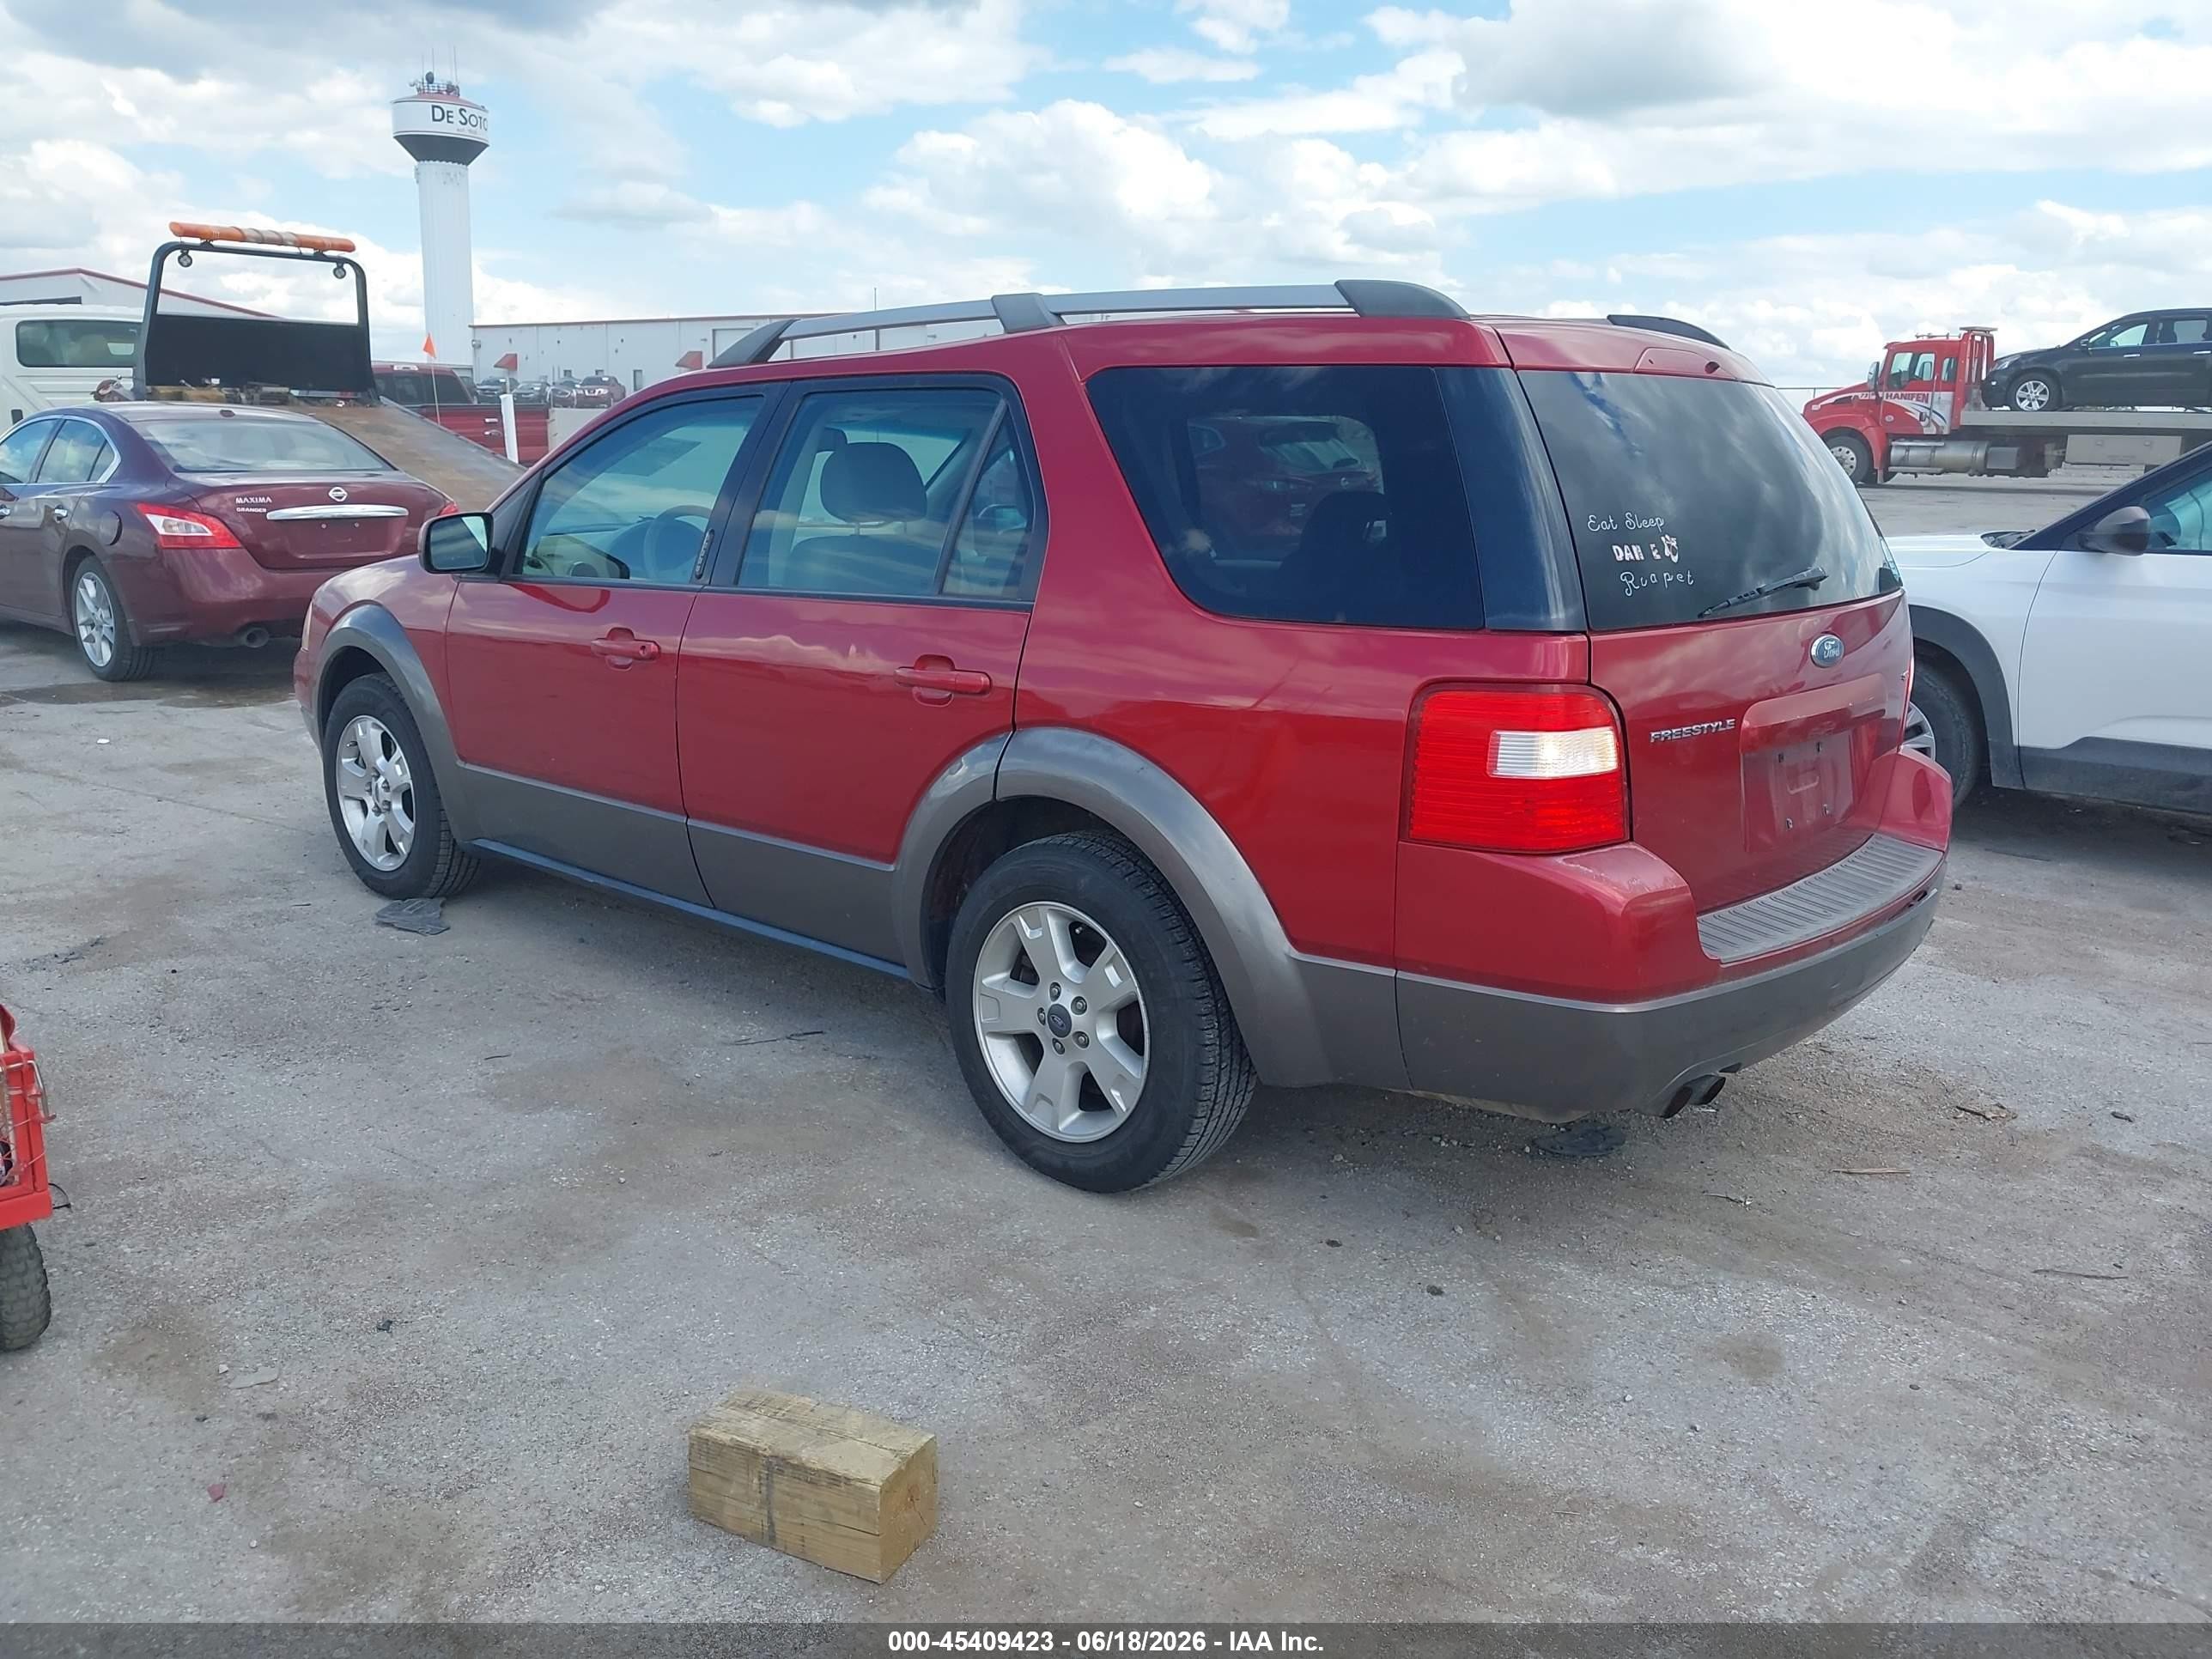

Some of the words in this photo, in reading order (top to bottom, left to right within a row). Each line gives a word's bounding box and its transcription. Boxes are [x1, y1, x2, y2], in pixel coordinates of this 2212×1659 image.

[1587, 514, 1618, 532] Eat
[1625, 512, 1664, 532] Sleep
[1650, 719, 1736, 743] FREESTYLE
